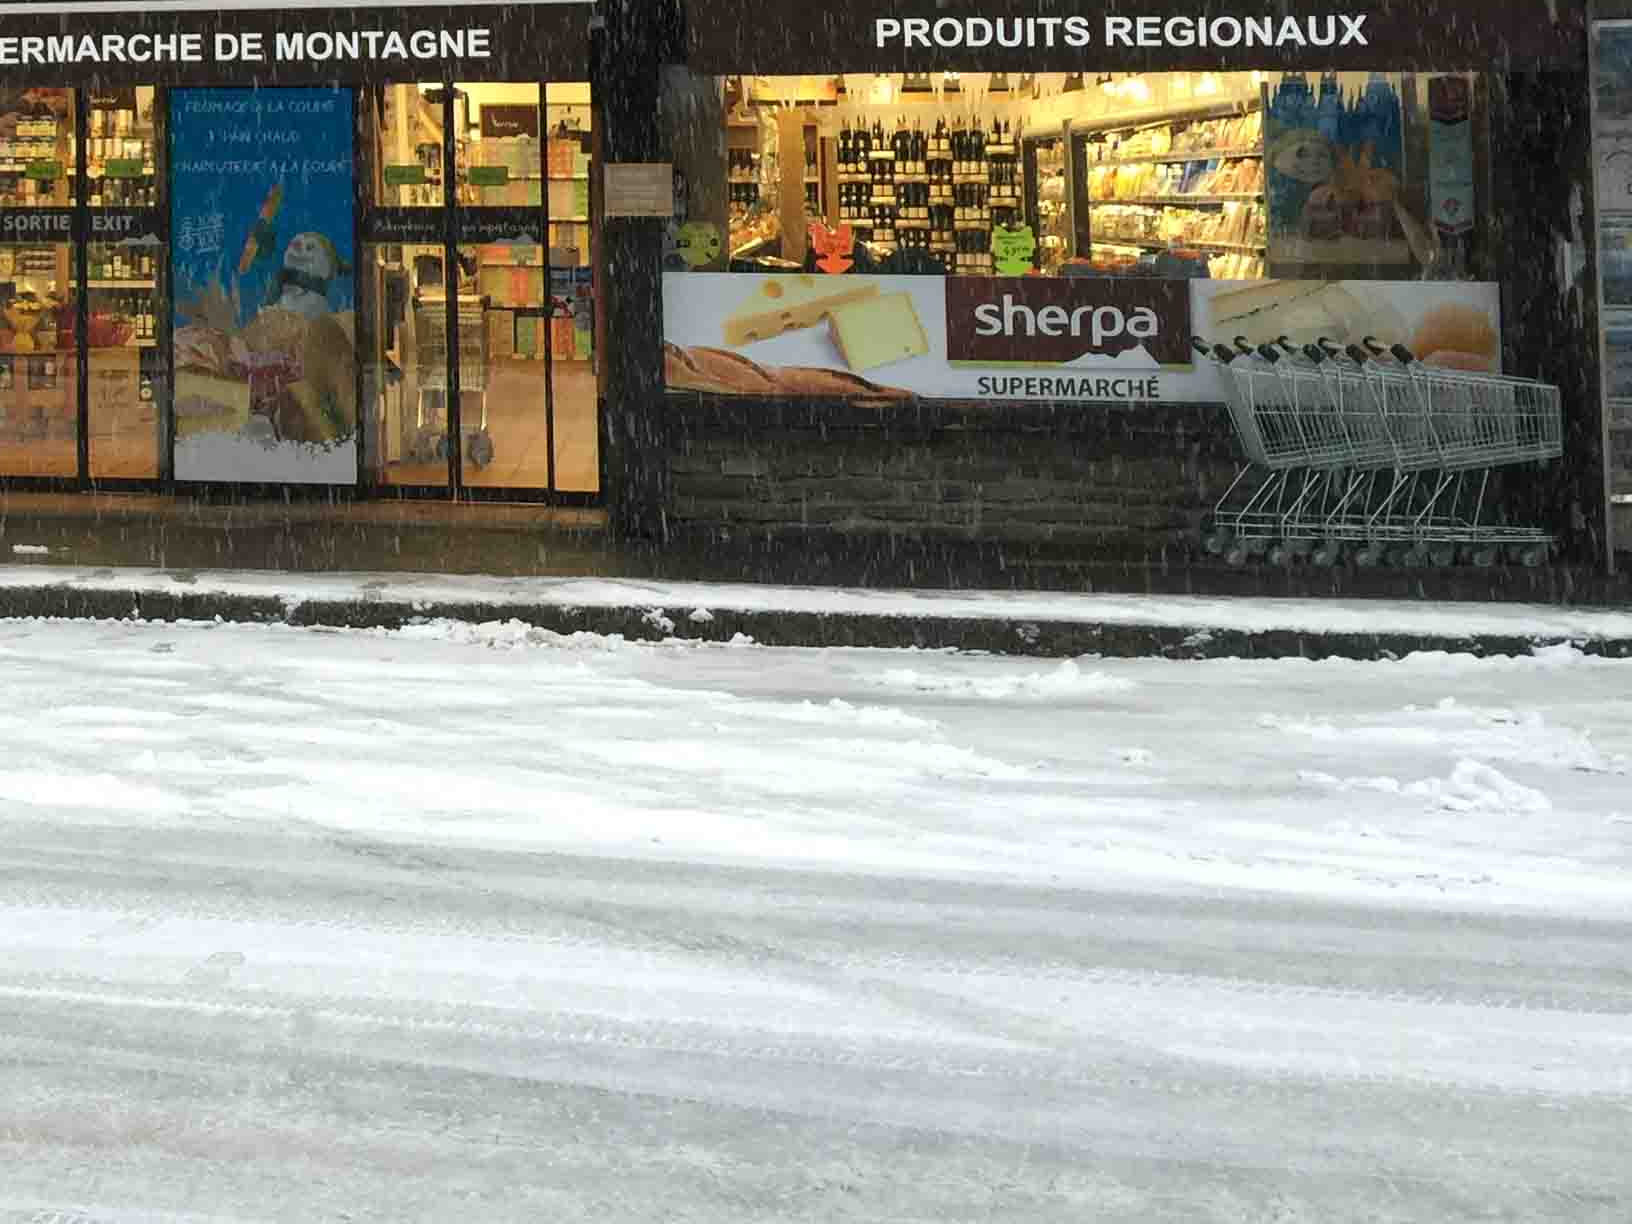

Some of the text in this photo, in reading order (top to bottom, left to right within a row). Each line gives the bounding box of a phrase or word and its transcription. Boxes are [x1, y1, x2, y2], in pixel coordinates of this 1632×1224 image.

[214, 33, 263, 63] DE
[275, 29, 491, 61] MONTAGNE
[875, 15, 1368, 48] PRODUITS REGIONAUX
[3, 215, 134, 232] SORTIE EXIT
[975, 294, 1158, 346] sherpa
[978, 376, 1161, 398] SUPERMARCHÉ
